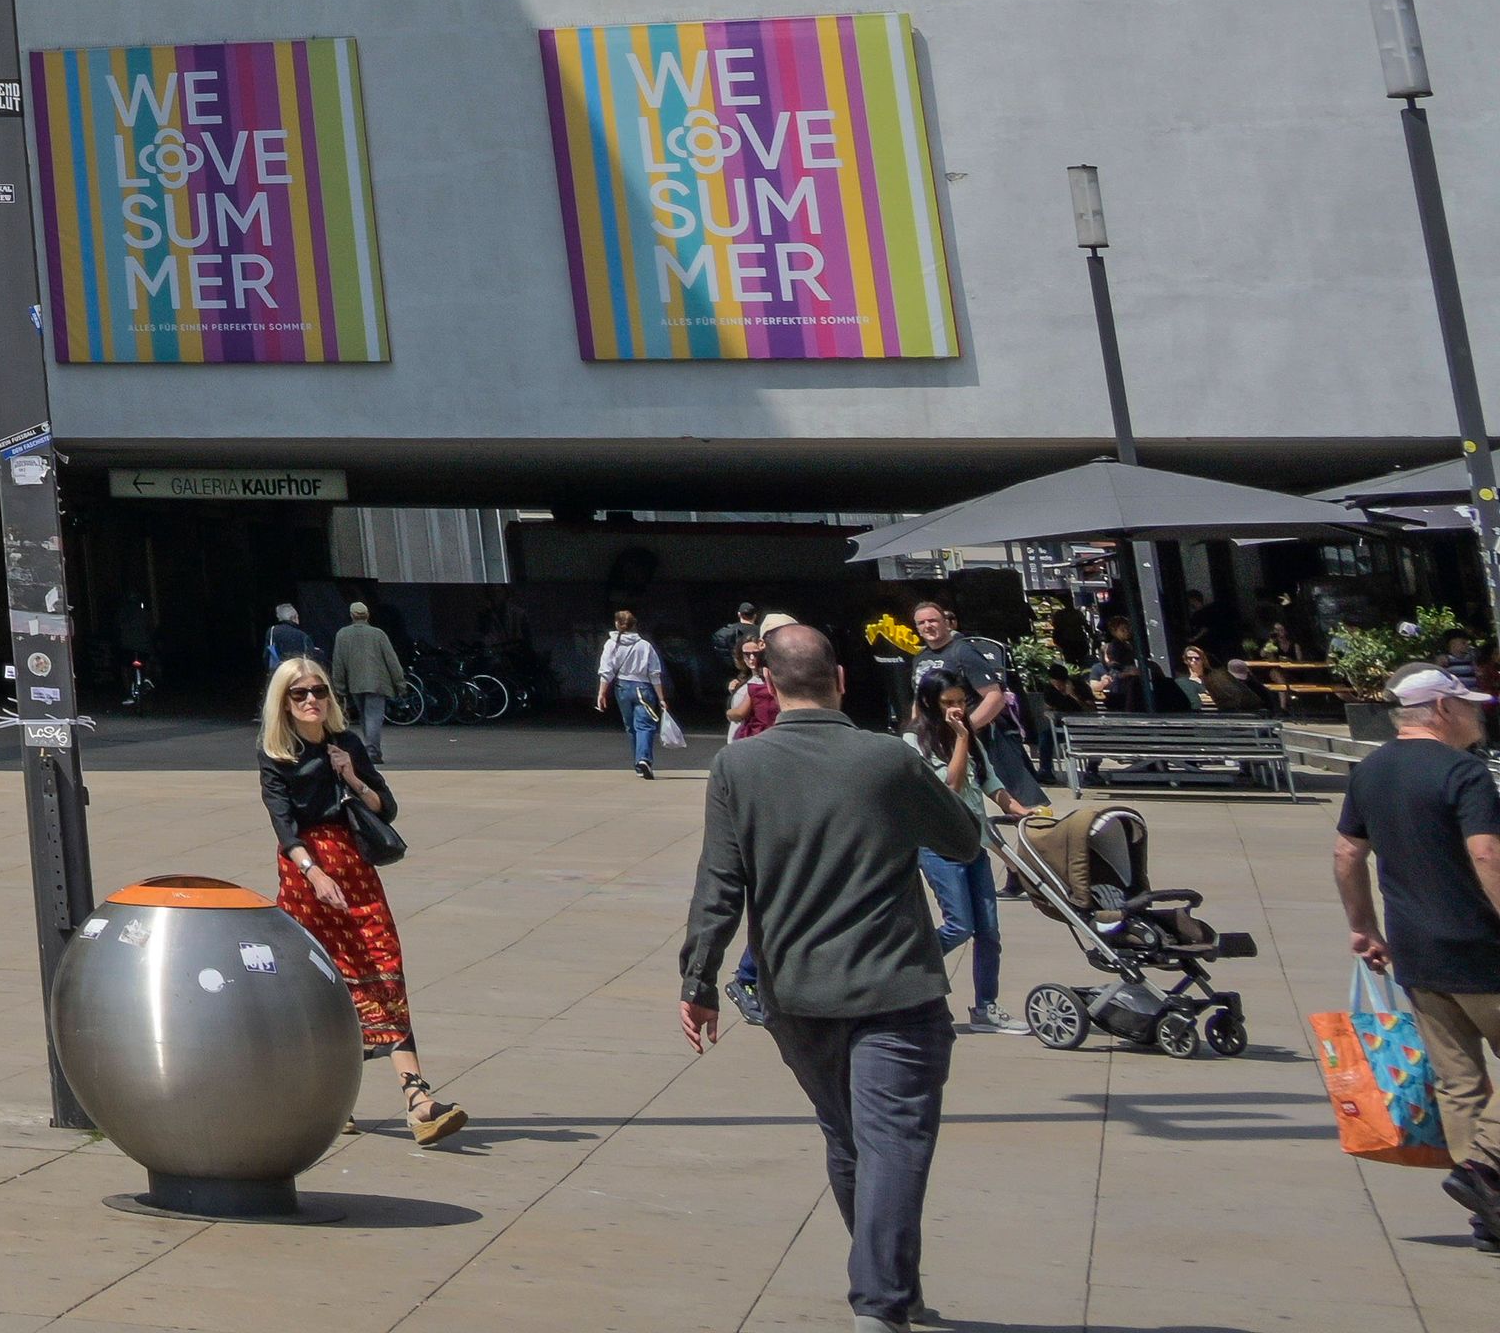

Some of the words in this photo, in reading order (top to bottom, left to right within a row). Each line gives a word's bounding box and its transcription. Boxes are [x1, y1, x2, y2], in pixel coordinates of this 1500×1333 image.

[105, 70, 222, 127] WE
[625, 48, 761, 109] WE
[121, 191, 273, 249] SUM
[650, 176, 822, 238] SUM
[124, 253, 279, 310] MER
[653, 242, 833, 303] MER
[127, 323, 156, 333] ALLES
[158, 322, 177, 332] FÜR
[179, 323, 208, 332] EINEN
[211, 322, 266, 331] PERFEKTEN
[269, 322, 312, 331] SOMMER
[660, 317, 693, 327] ALLES
[695, 316, 718, 326] FÜR
[719, 317, 752, 326] EINEN
[755, 316, 817, 326] PERFEKTEN
[819, 315, 871, 325] SOMMER
[11, 429, 37, 443] FUSSBALL
[171, 477, 237, 495] GALERIA
